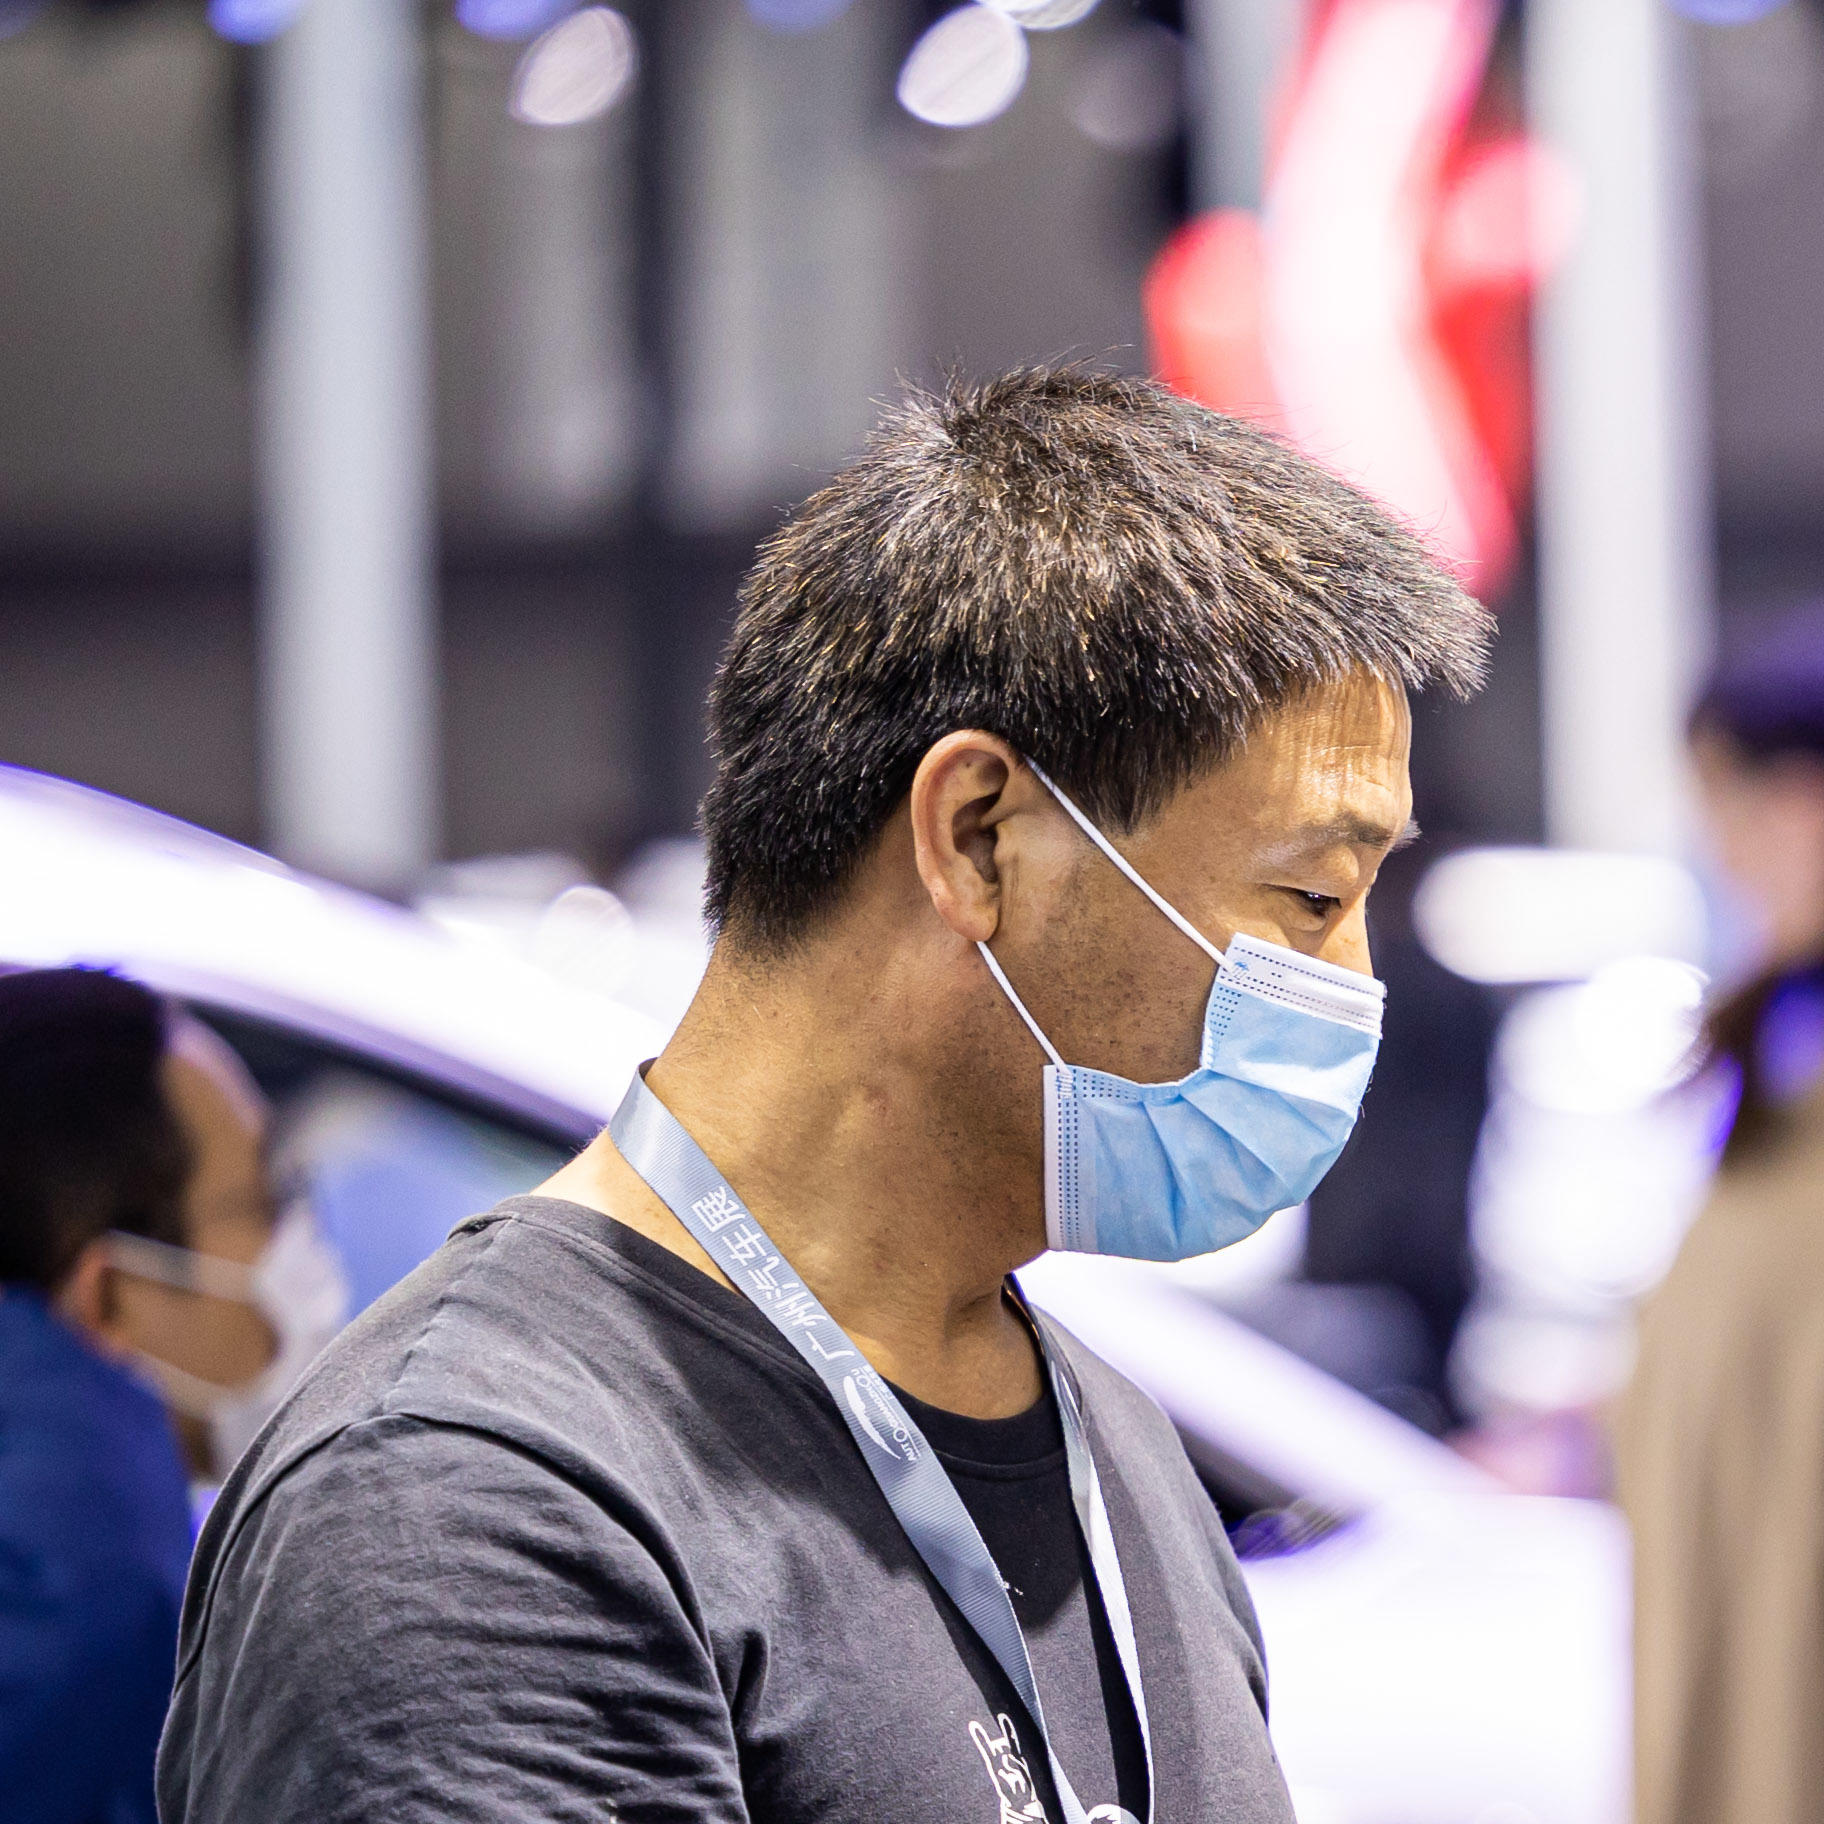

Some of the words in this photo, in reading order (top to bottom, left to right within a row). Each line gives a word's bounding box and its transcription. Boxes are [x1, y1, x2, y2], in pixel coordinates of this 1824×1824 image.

[691, 1186, 855, 1361] 广州汽车展
